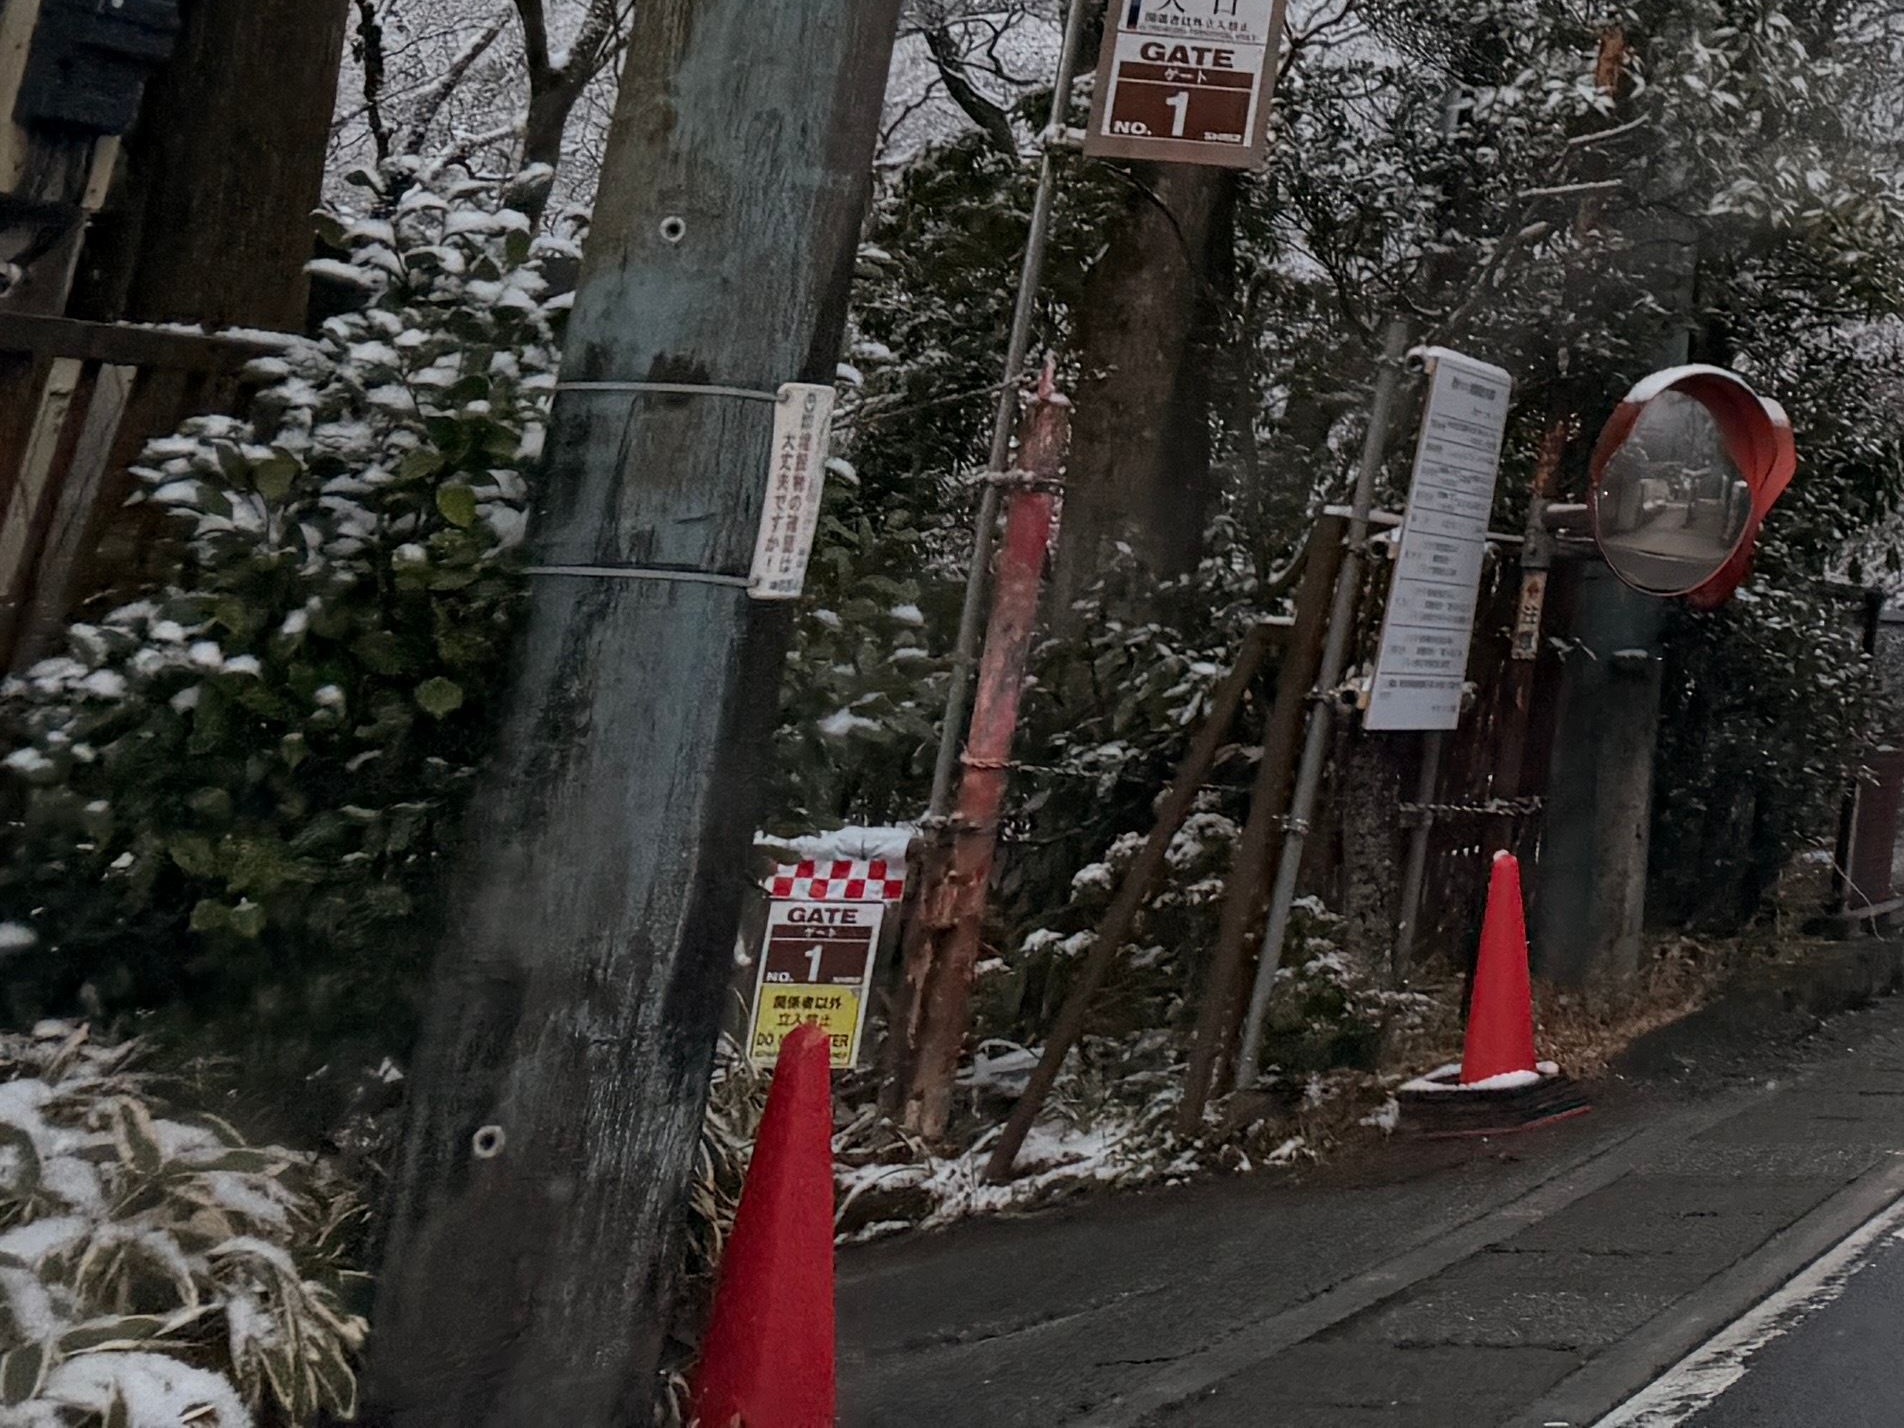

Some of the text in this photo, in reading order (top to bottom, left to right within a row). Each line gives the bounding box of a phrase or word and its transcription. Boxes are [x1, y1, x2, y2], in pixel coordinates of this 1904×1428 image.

[1140, 42, 1235, 68] GATE
[1164, 68, 1208, 84] ゲート
[1113, 90, 1190, 137] NO. 1
[787, 907, 859, 924] GATE
[804, 944, 823, 982] 1
[773, 995, 842, 1010] 関係者以外
[757, 1032, 774, 1046] DO
